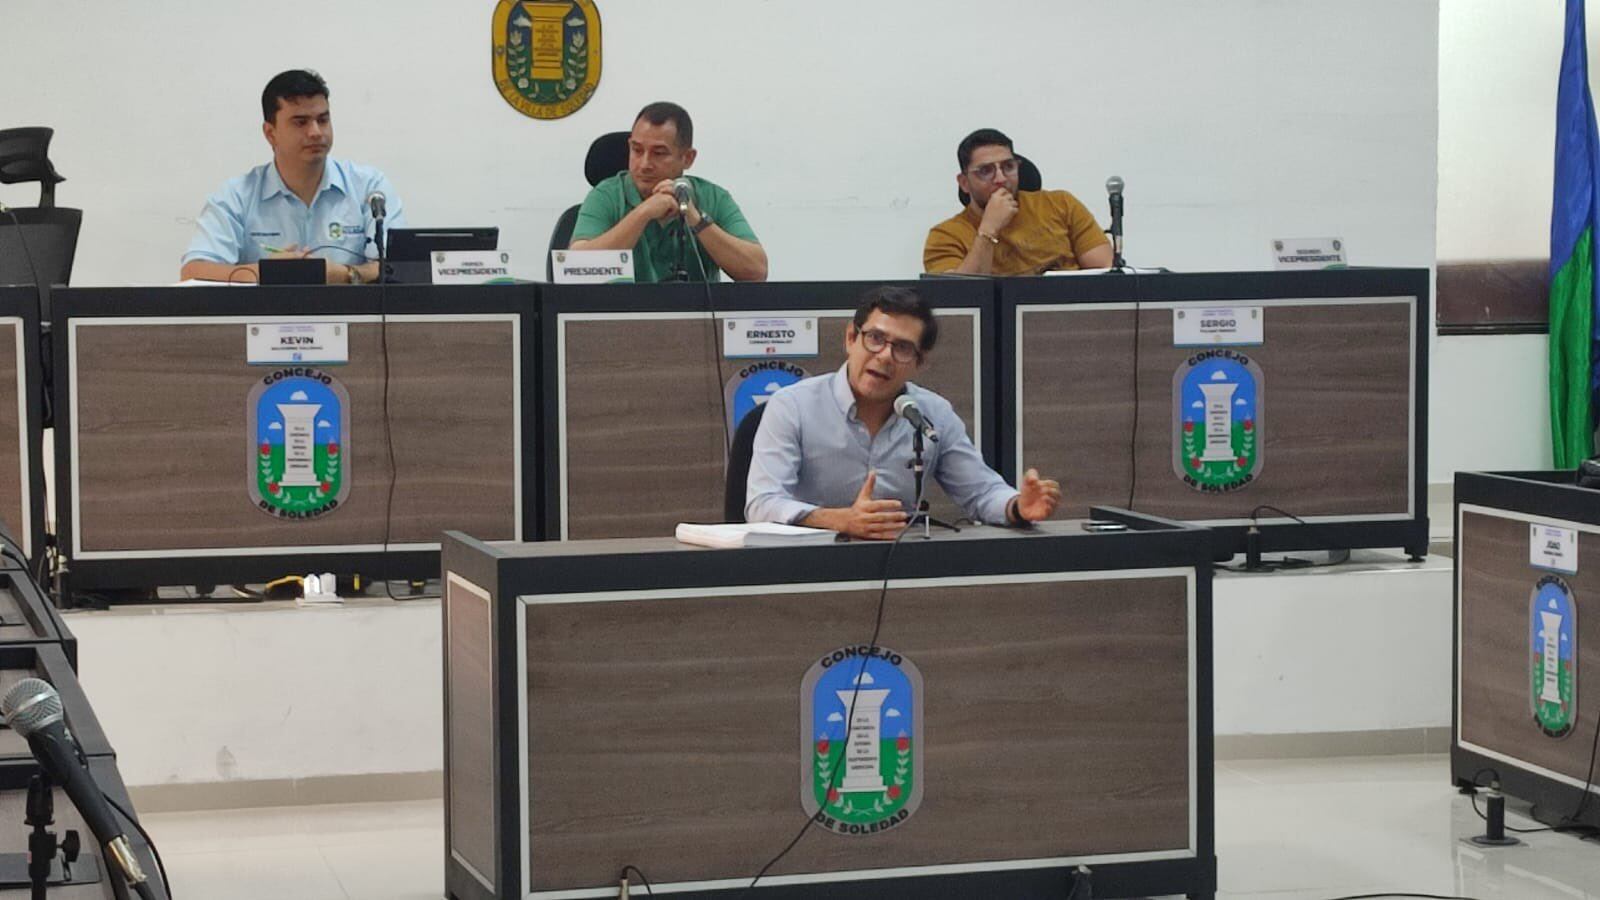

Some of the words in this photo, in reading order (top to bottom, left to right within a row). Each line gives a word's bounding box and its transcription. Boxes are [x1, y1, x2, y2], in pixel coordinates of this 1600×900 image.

[1278, 255, 1342, 263] VICEPRESIDENTE
[438, 267, 507, 276] VICEPRESIDENTE
[563, 267, 624, 276] PRESIDENTE
[1200, 319, 1236, 328] SERGIO
[280, 336, 314, 345] KEVIN
[746, 330, 795, 339] ERNESTO
[1188, 349, 1249, 367] CONCEJO
[263, 367, 333, 385] CONCEJO
[740, 361, 804, 378] CONCEJO
[1183, 474, 1198, 487] DE
[1201, 473, 1253, 491] SOLEDAD
[259, 499, 276, 513] DE
[280, 499, 338, 518] SOLEDAD
[821, 646, 902, 668] CONCEJO
[815, 812, 835, 828] DE
[839, 808, 909, 834] SOLEDAD
